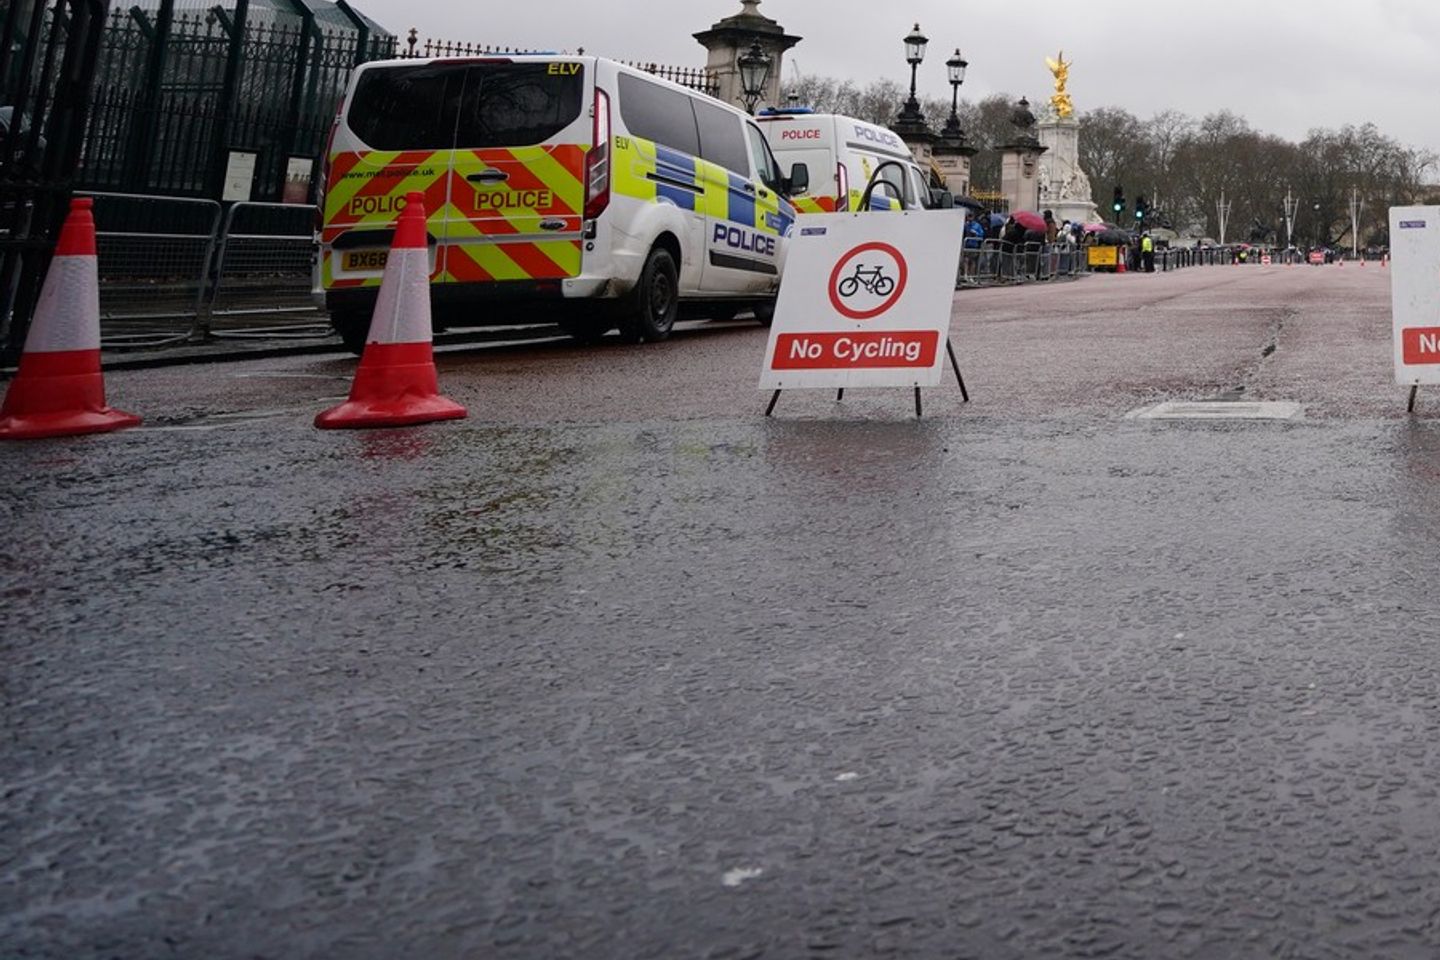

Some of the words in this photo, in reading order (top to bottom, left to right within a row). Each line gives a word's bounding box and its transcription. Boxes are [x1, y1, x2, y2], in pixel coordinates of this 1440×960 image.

[547, 63, 580, 75] ELV
[782, 129, 821, 140] POLICE
[854, 125, 899, 149] POLICE
[351, 195, 408, 214] POLIC
[478, 190, 550, 209] POLICE
[713, 223, 776, 257] POLICE
[349, 251, 388, 268] BX68
[789, 339, 822, 359] No
[833, 337, 921, 362] Cycling
